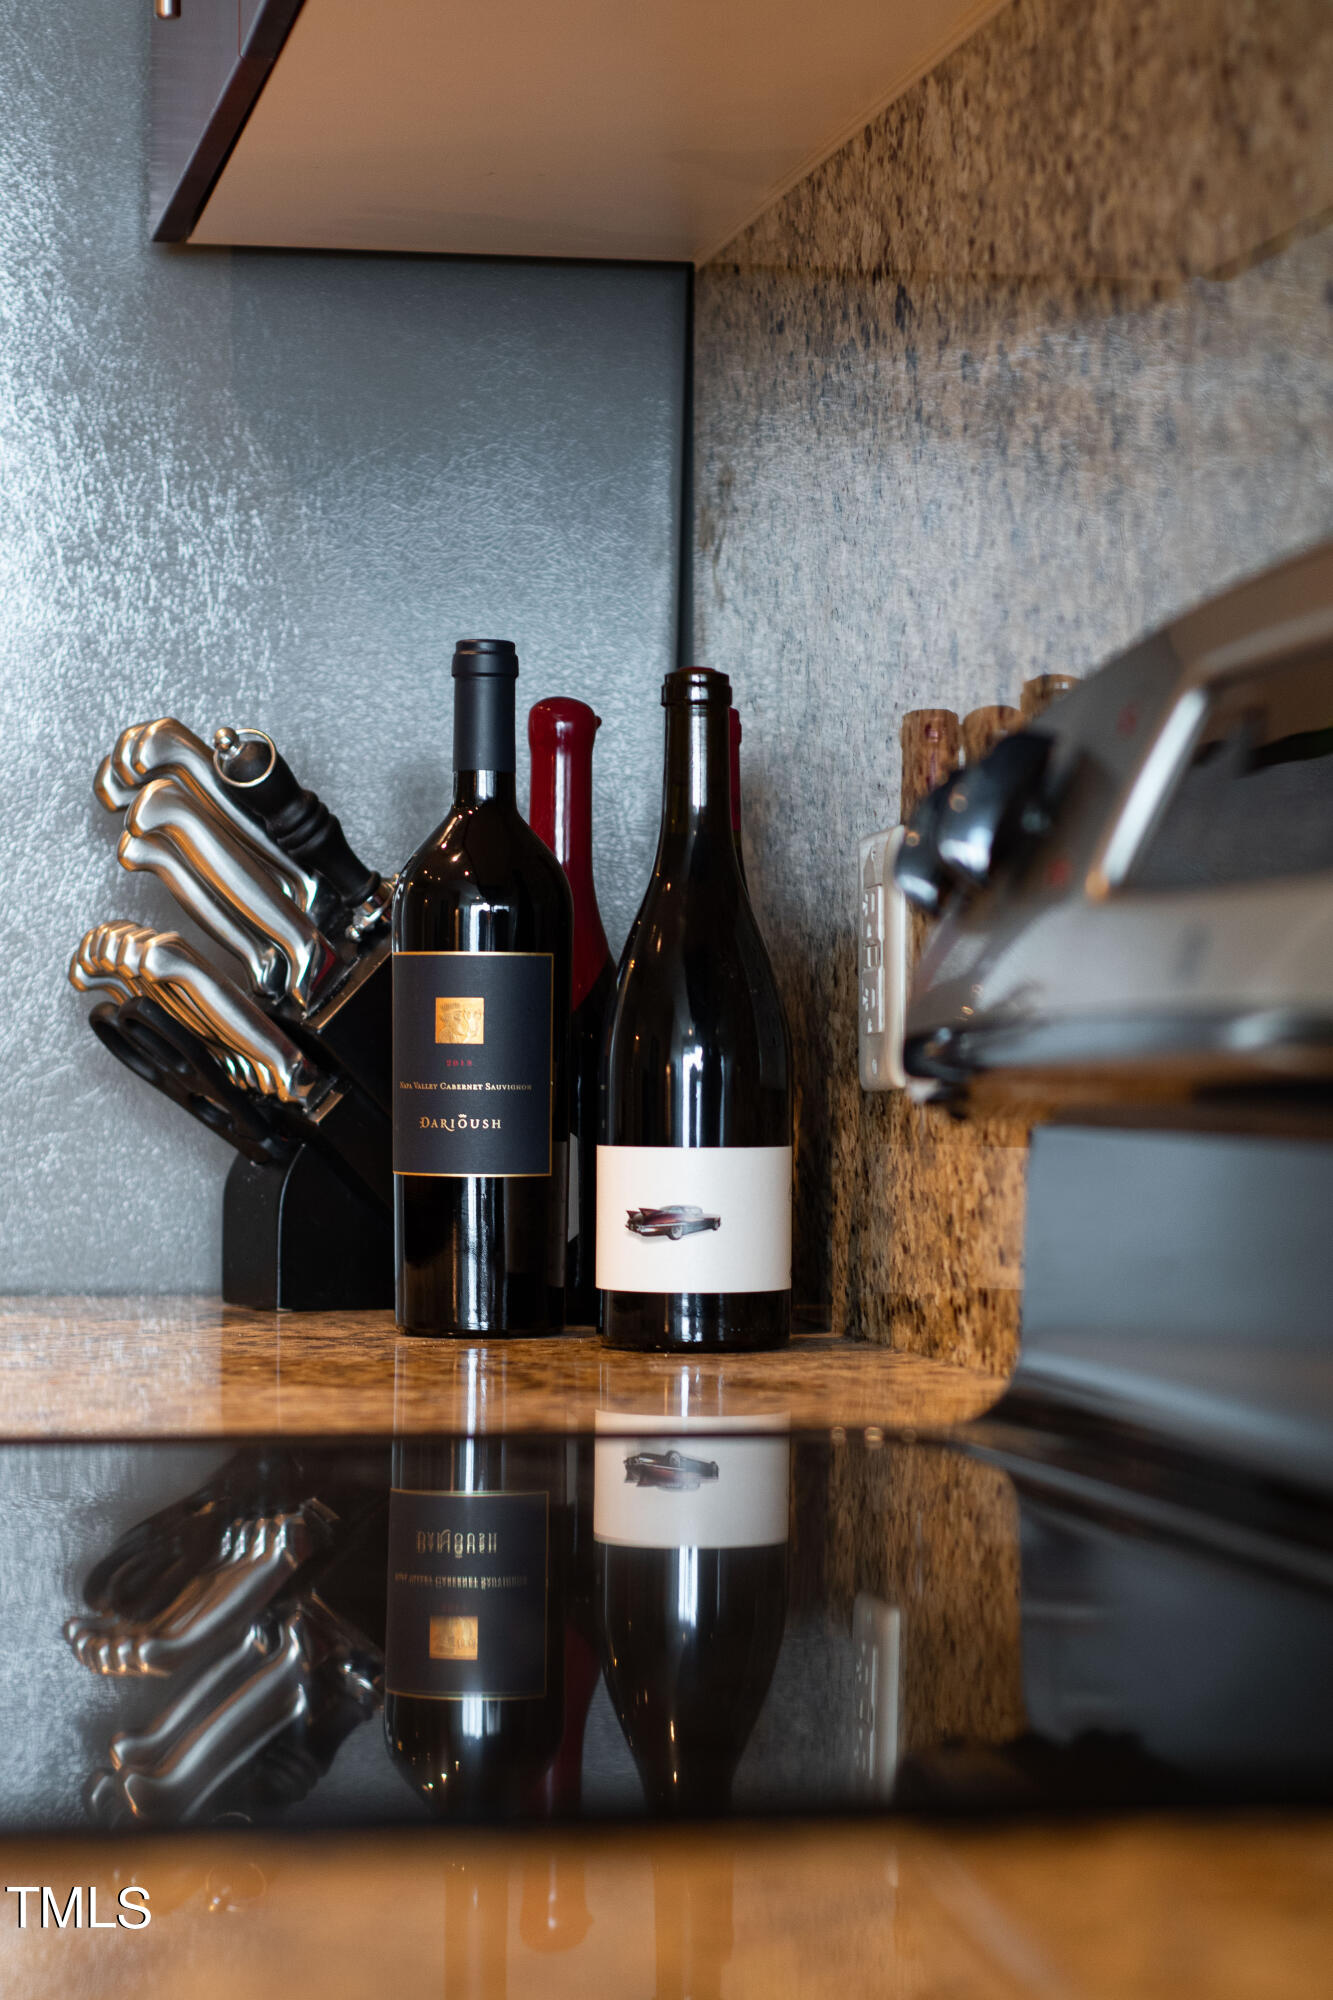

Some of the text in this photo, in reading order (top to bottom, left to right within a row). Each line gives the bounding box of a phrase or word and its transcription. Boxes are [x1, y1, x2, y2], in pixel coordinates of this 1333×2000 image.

[413, 1081, 438, 1090] VALLEY
[440, 1082, 483, 1091] CABERNET
[485, 1082, 532, 1091] SAUVIGNON
